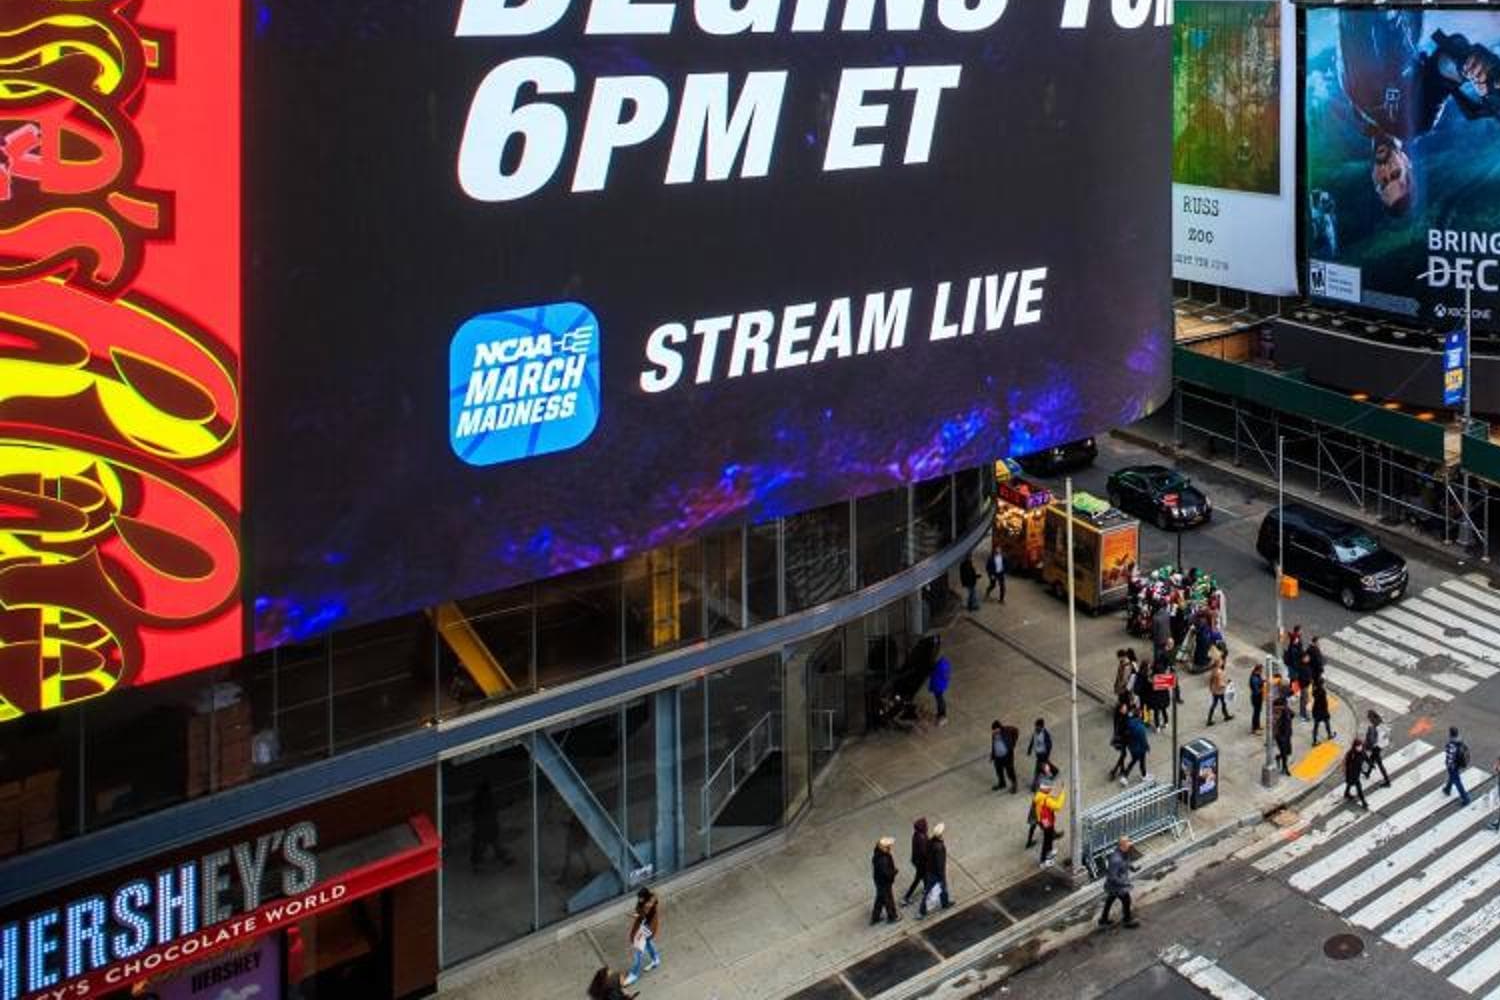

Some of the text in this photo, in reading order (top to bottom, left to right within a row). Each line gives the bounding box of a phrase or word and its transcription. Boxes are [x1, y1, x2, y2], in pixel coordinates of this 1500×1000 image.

[456, 56, 963, 202] 6PM ET
[1183, 196, 1219, 217] RUSS
[474, 334, 552, 368] NCAA
[639, 268, 1047, 393] STREAM LIVE
[464, 353, 587, 406] MARCH
[455, 391, 578, 438] MADNESS
[104, 920, 257, 984] CHOCOLATE
[265, 884, 347, 925] WORLD
[190, 952, 262, 993] HERSHEY
